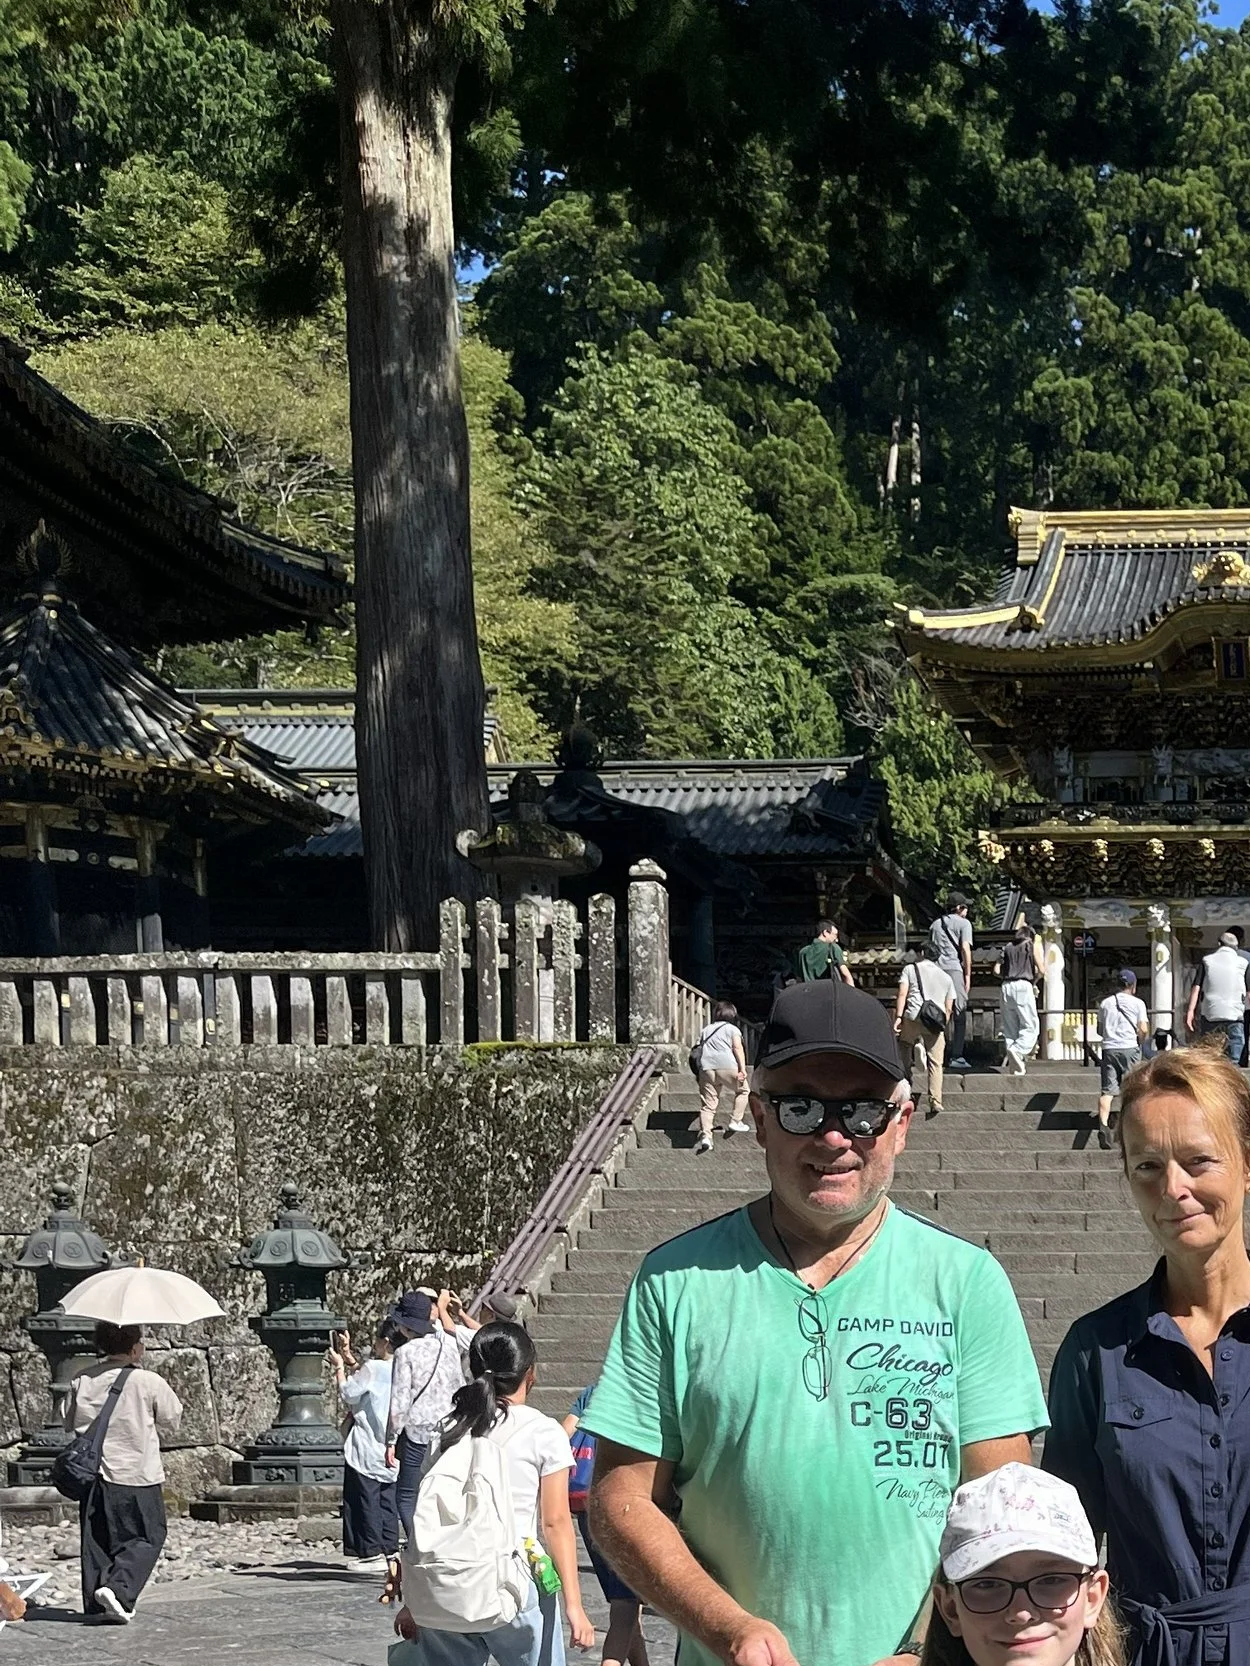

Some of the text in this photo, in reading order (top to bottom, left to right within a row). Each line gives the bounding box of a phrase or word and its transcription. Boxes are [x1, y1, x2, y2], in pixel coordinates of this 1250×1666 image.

[837, 1317, 953, 1337] CAMP DAVID
[846, 1343, 953, 1385] Chicago
[847, 1374, 955, 1405] Lake Michigan
[850, 1397, 932, 1430] C-63
[876, 1478, 919, 1507] Navy
